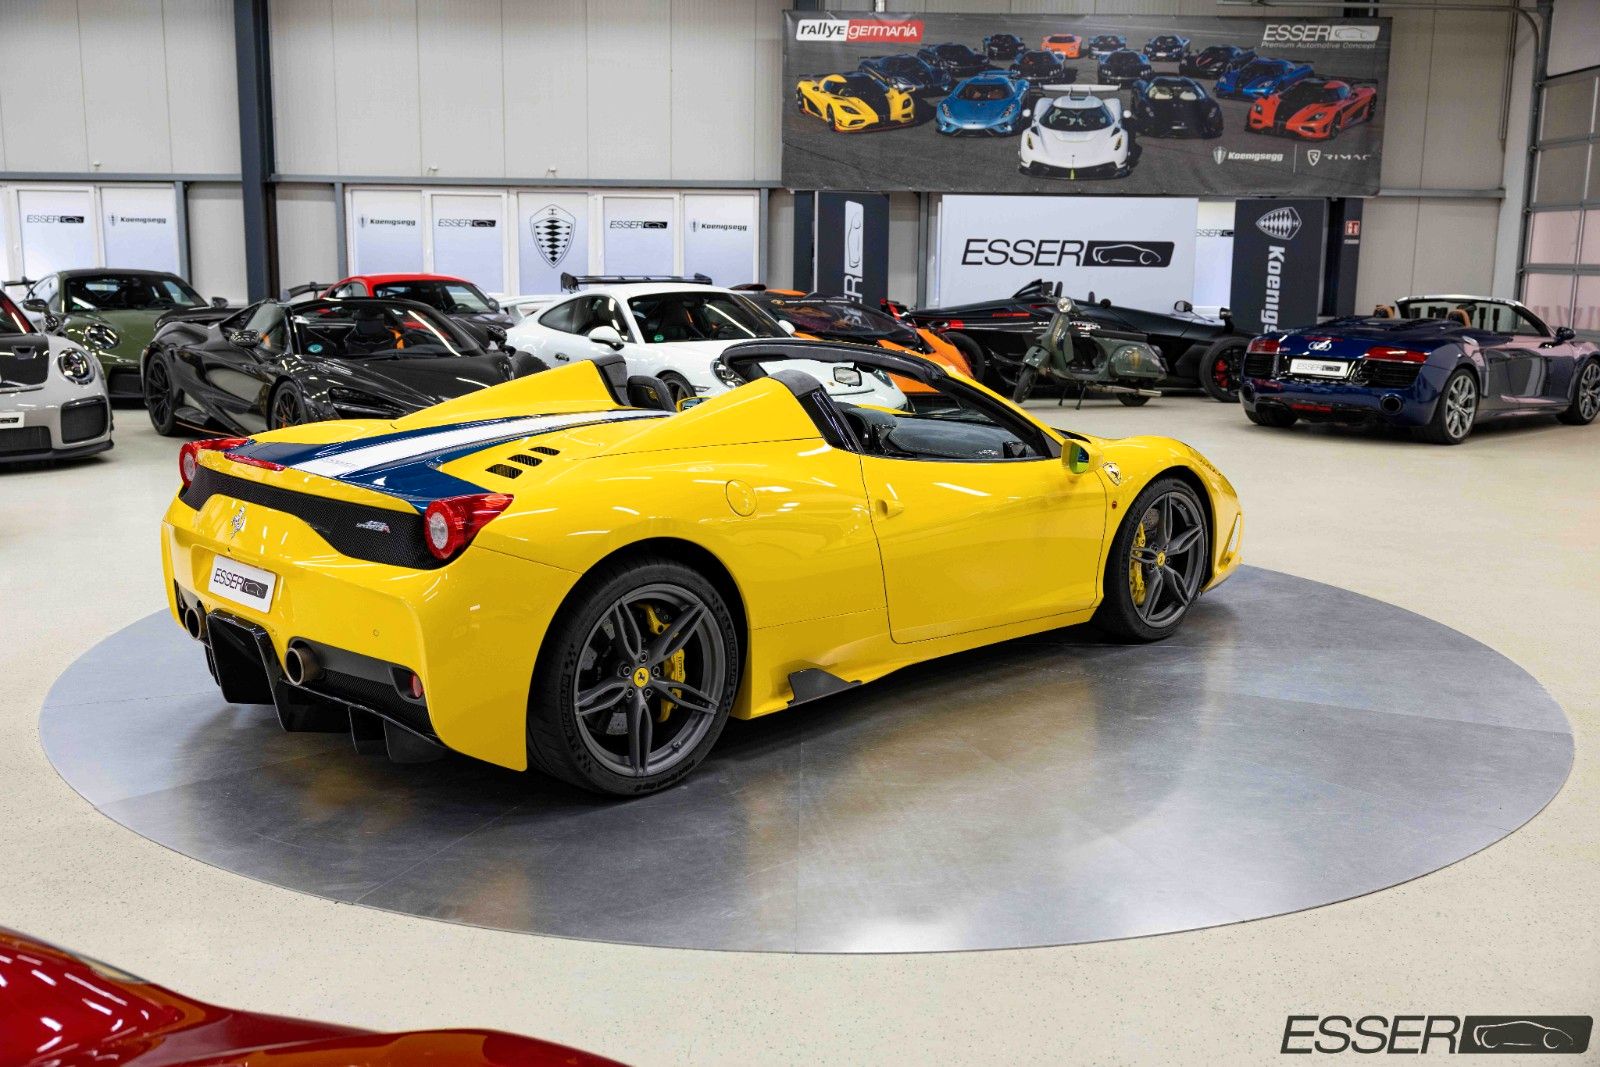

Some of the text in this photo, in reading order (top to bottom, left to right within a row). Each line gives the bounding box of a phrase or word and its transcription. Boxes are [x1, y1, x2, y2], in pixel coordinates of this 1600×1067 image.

[1262, 24, 1331, 41] ESSER
[1227, 151, 1284, 162] Koenigsegg
[26, 215, 61, 224] ESSER
[120, 216, 167, 225] Koenigsegg
[370, 218, 416, 227] Koenigsegg
[438, 218, 472, 227] ESSER
[609, 221, 644, 229] ESSER
[701, 223, 748, 232] Koenigsegg
[1195, 229, 1221, 238] SSER
[961, 238, 1085, 267] ESSER
[1261, 245, 1286, 334] Koenigs
[213, 567, 245, 591] ESSER
